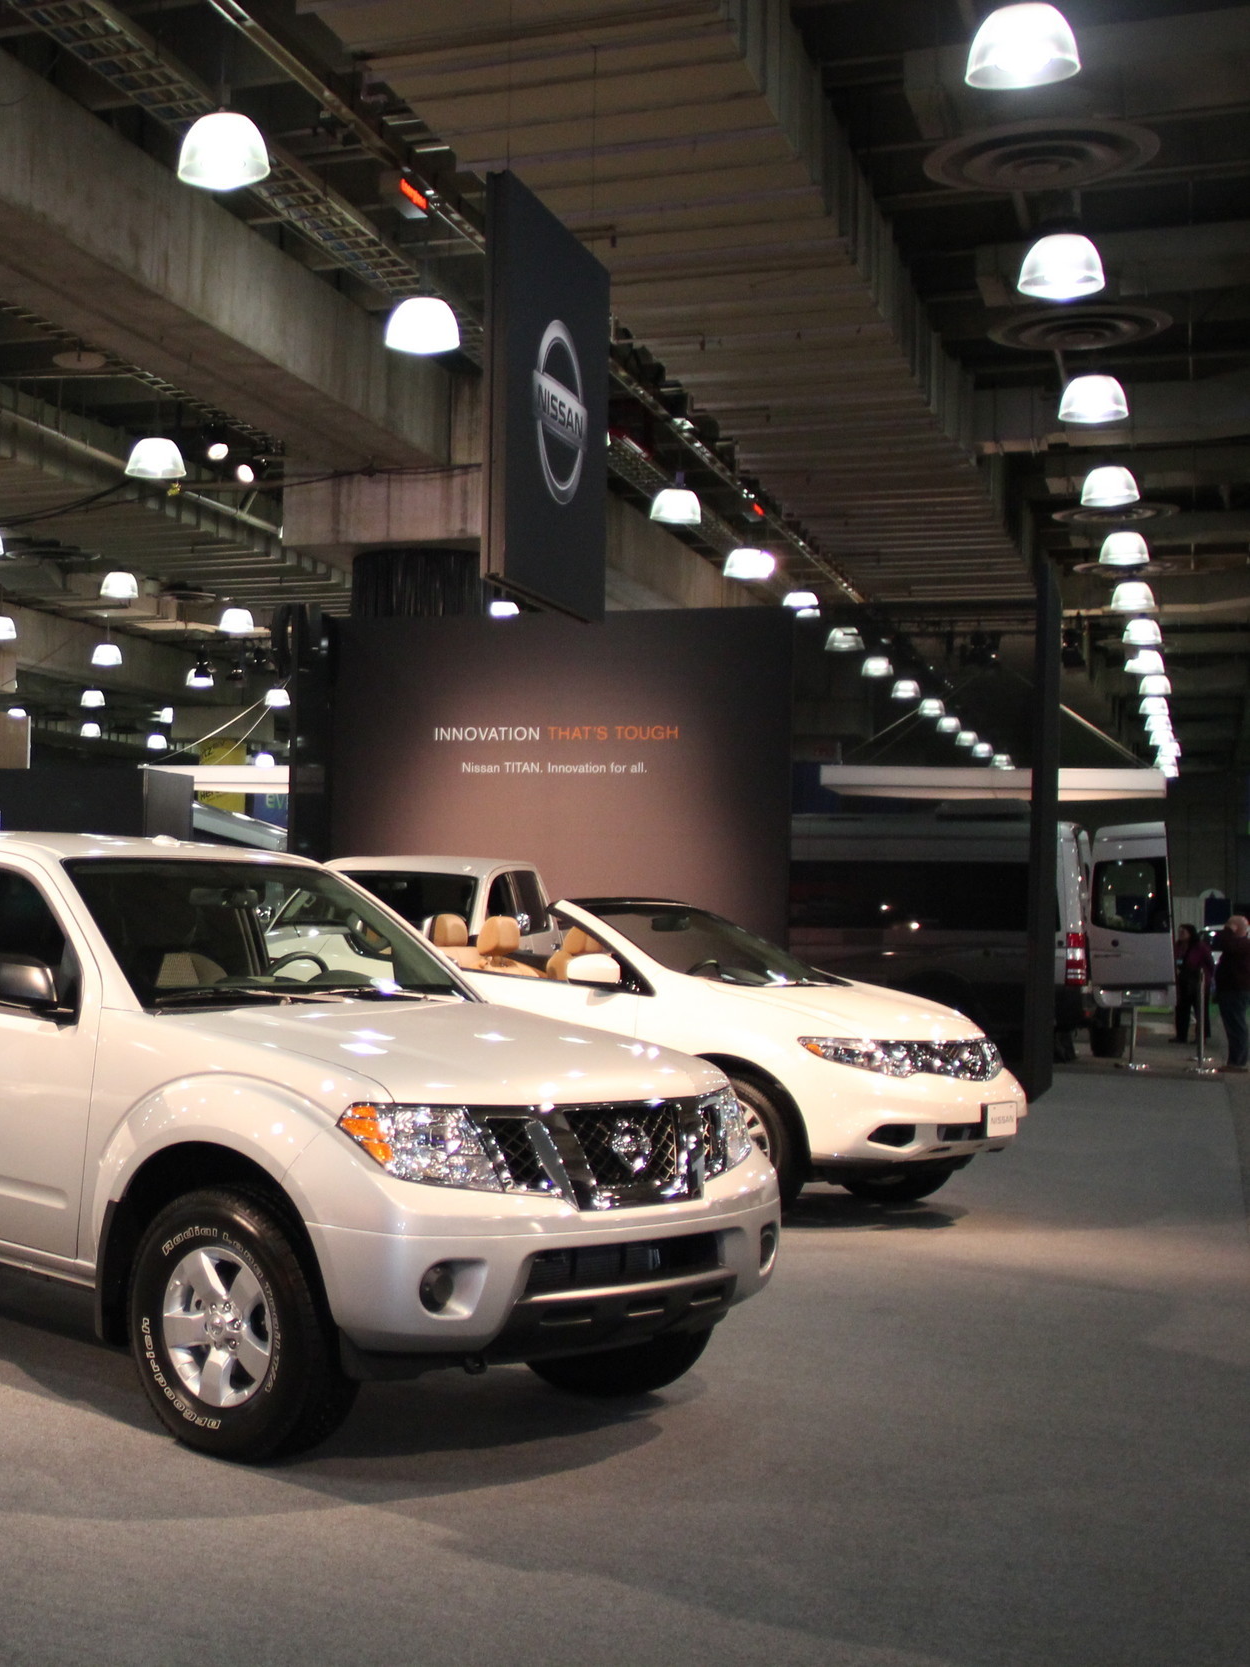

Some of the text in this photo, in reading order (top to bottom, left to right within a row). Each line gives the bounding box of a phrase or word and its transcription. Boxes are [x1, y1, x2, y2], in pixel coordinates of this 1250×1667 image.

[537, 384, 584, 440] NISSAN
[434, 725, 679, 741] INNOVATION THAT'S TOUGH
[461, 761, 648, 774] Nissan TITAN. Innovation for all.
[161, 1225, 218, 1257] Radial
[141, 1316, 222, 1430] BFGoodrich
